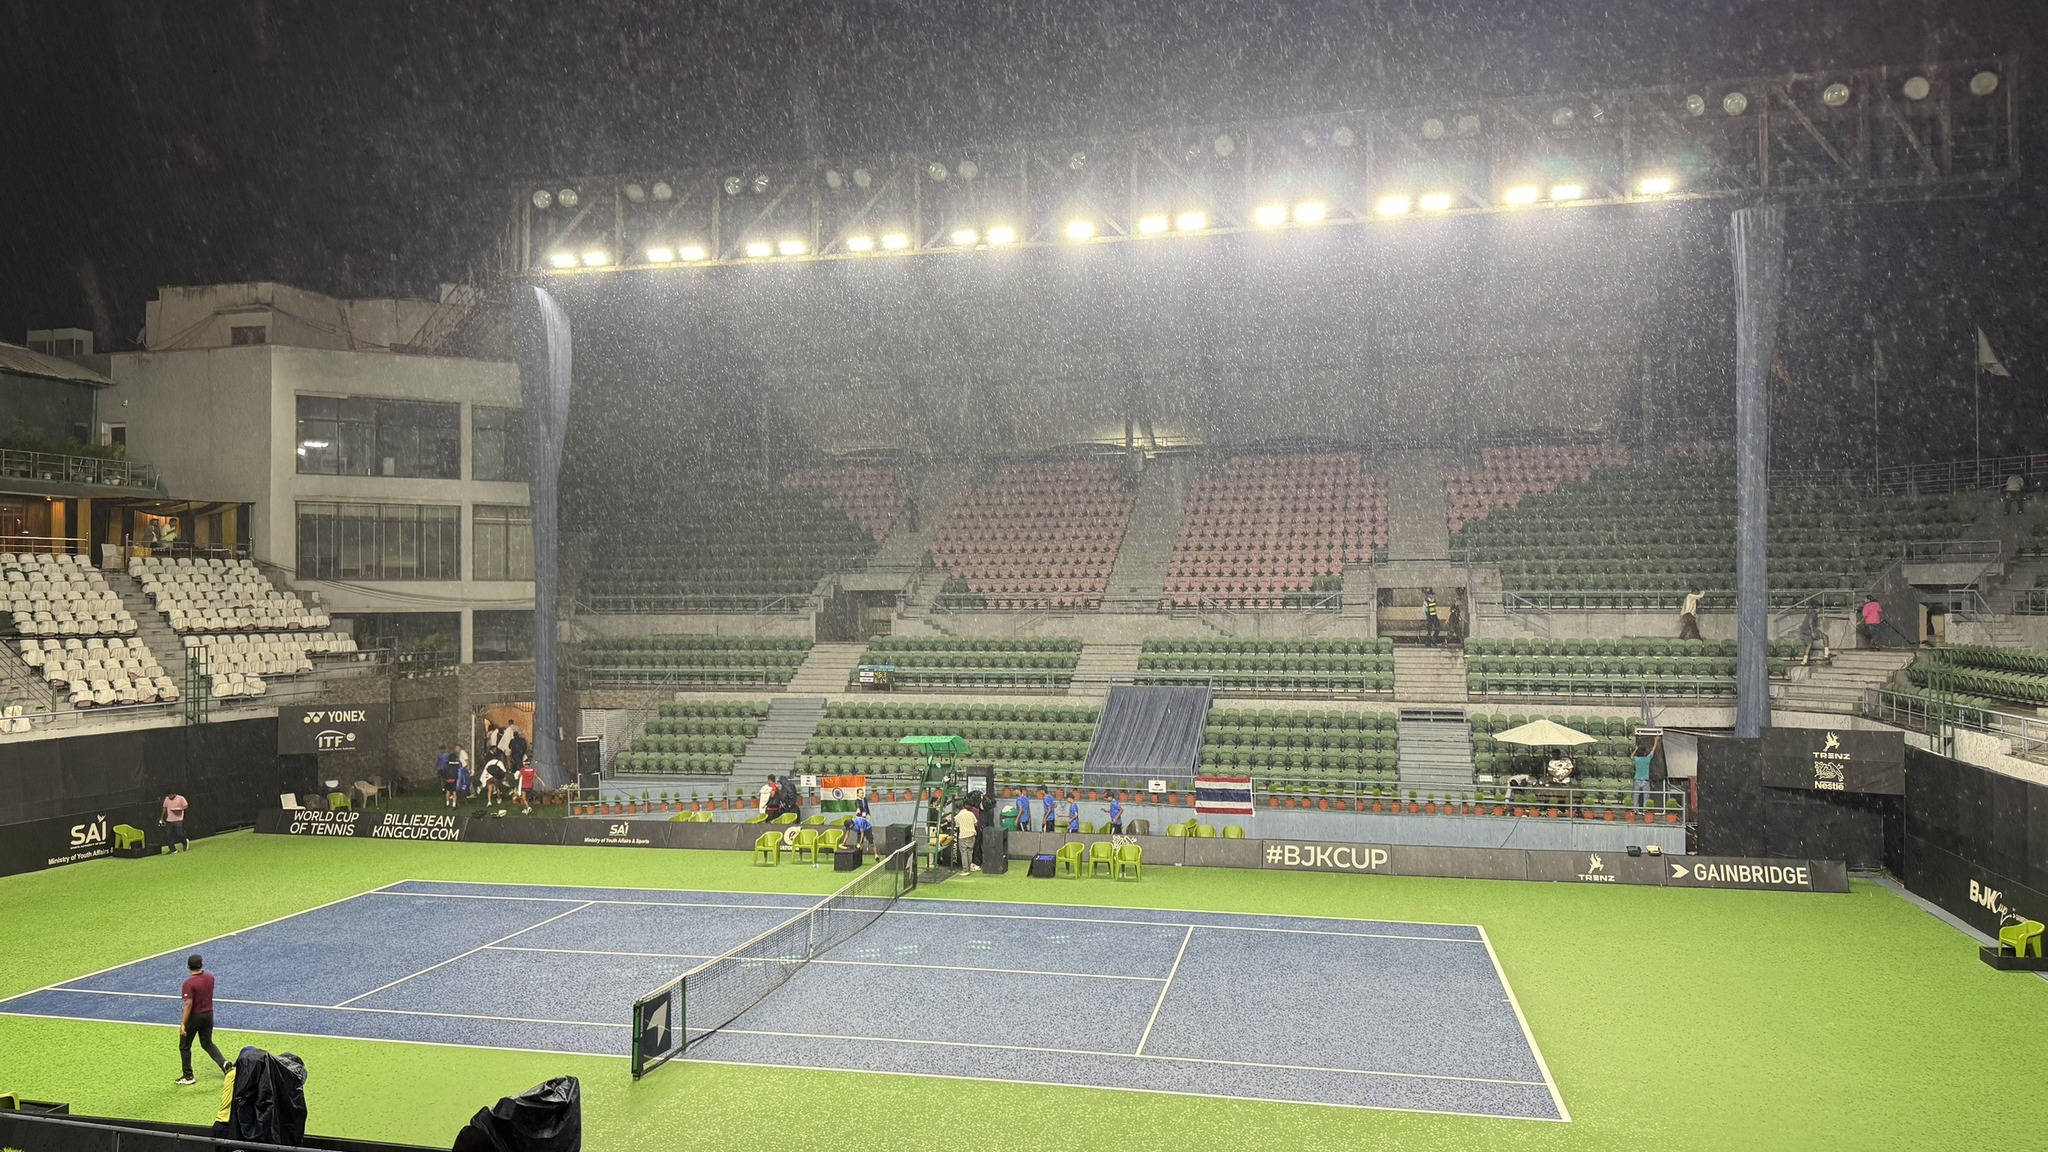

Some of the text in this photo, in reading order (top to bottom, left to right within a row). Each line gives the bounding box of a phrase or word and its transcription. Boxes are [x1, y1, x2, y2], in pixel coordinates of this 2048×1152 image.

[327, 710, 366, 723] YONEX
[318, 735, 344, 748] ITF
[1812, 751, 1851, 760] TRENZ
[293, 810, 360, 823] WORLD CUP
[383, 813, 456, 828] BILLIEJEAN
[70, 819, 107, 846] SAI
[289, 823, 356, 836] OF TENNIS
[372, 826, 460, 841] KINGCUP.COM
[609, 823, 629, 835] SAI
[48, 856, 70, 865] Ministry
[77, 851, 93, 860] Youth
[92, 848, 110, 857] Affairs
[1266, 844, 1389, 870] #BJKCUP
[1578, 873, 1615, 882] TRENZ
[1693, 863, 1809, 885] GAINBRIDGE
